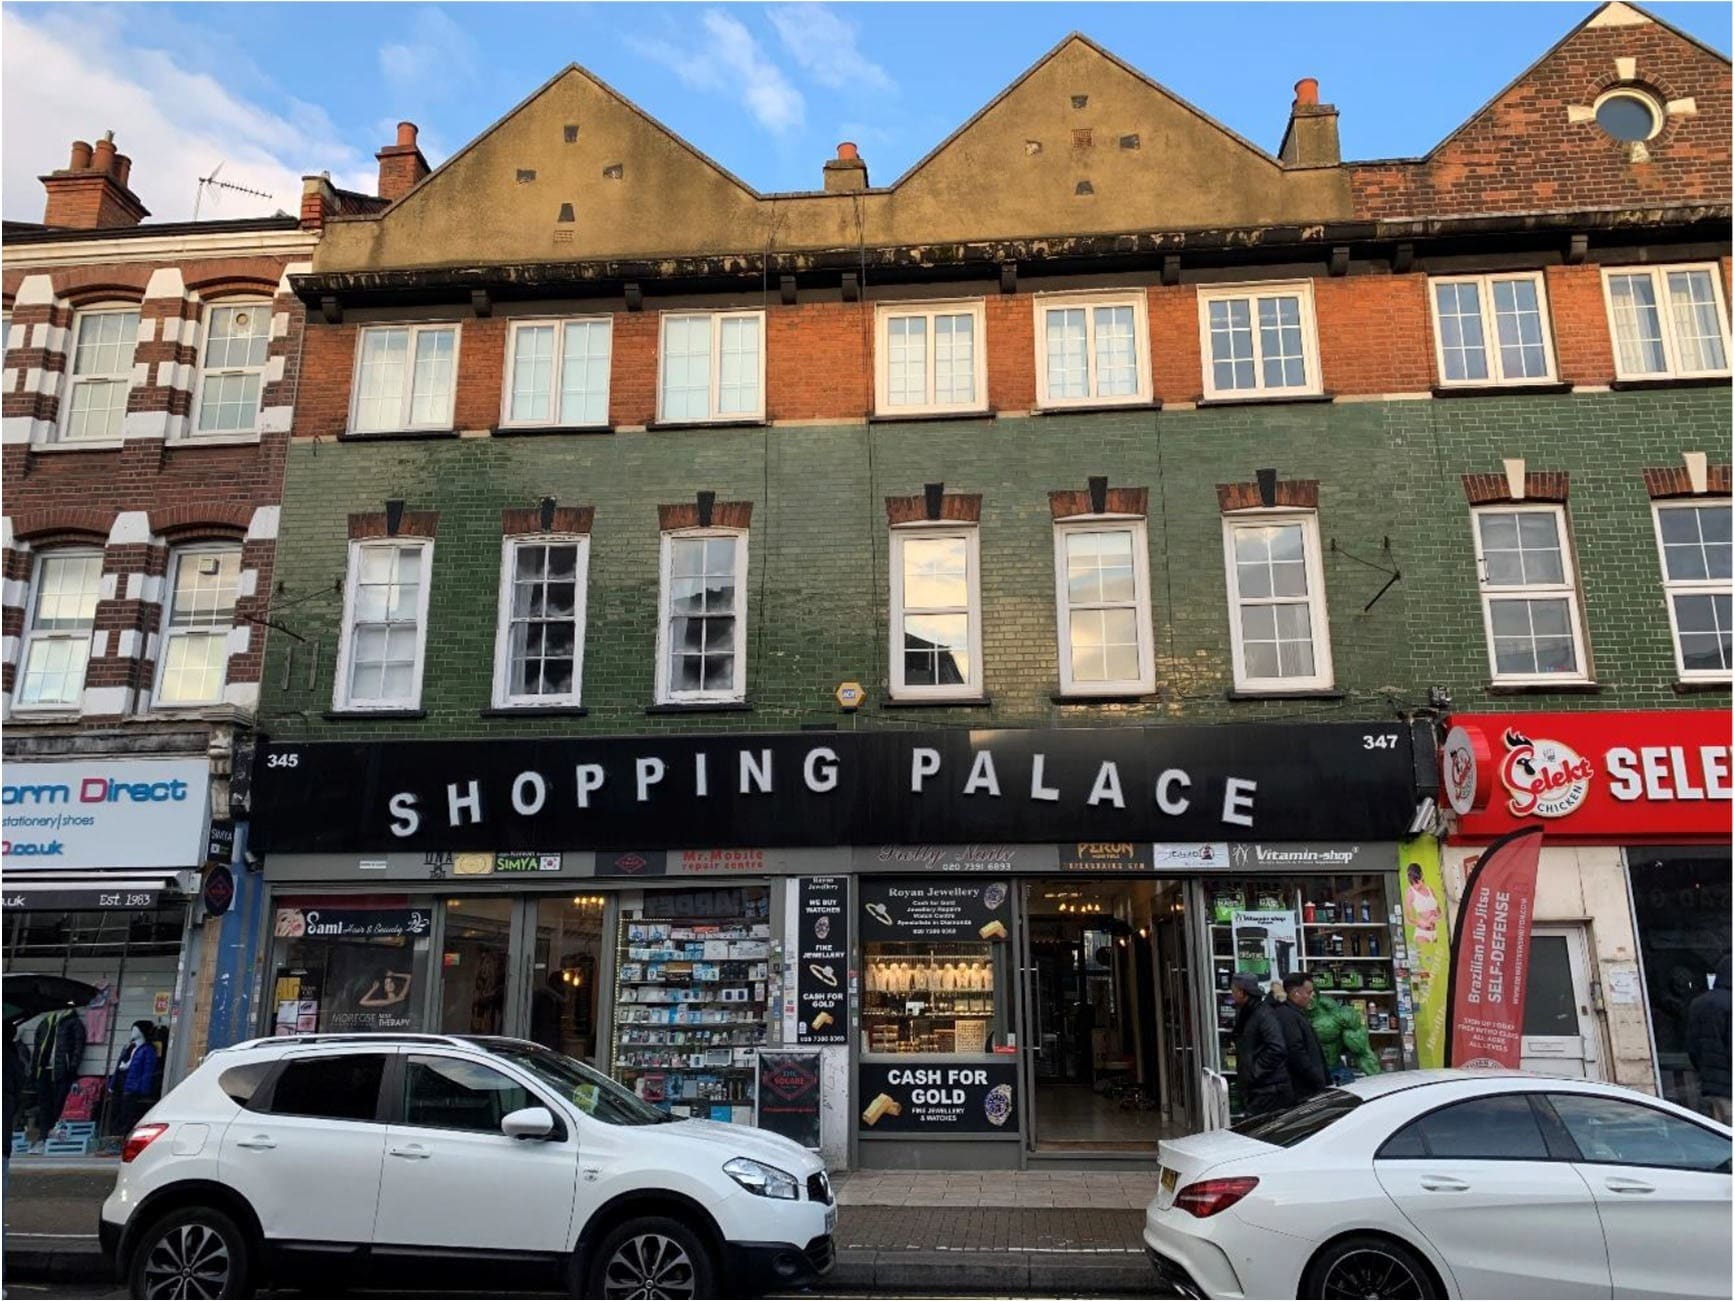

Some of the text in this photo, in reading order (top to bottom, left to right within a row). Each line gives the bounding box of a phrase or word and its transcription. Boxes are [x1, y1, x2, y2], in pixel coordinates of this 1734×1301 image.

[1362, 734, 1399, 750] 347
[267, 753, 299, 768] 345
[1605, 745, 1733, 801] SELE
[1502, 746, 1596, 817] Selekt
[80, 778, 188, 803] Direct
[388, 746, 1258, 838] SHOPPING PALACE
[1536, 783, 1584, 814] CHICKEN
[497, 857, 539, 871] SIMYA
[682, 860, 763, 871] repair centre
[942, 862, 1011, 871] 020 7391 6893
[125, 893, 152, 906] 1983
[889, 887, 980, 900] Royan Jewellery
[1467, 887, 1491, 1004] Brazilian Jiu-Jitsu
[1487, 891, 1511, 1003] SELF-DEFENSE
[1469, 1041, 1509, 1053] ALL LEVELS
[887, 1069, 989, 1085] CASH FOR
[911, 1089, 966, 1105] GOLD
